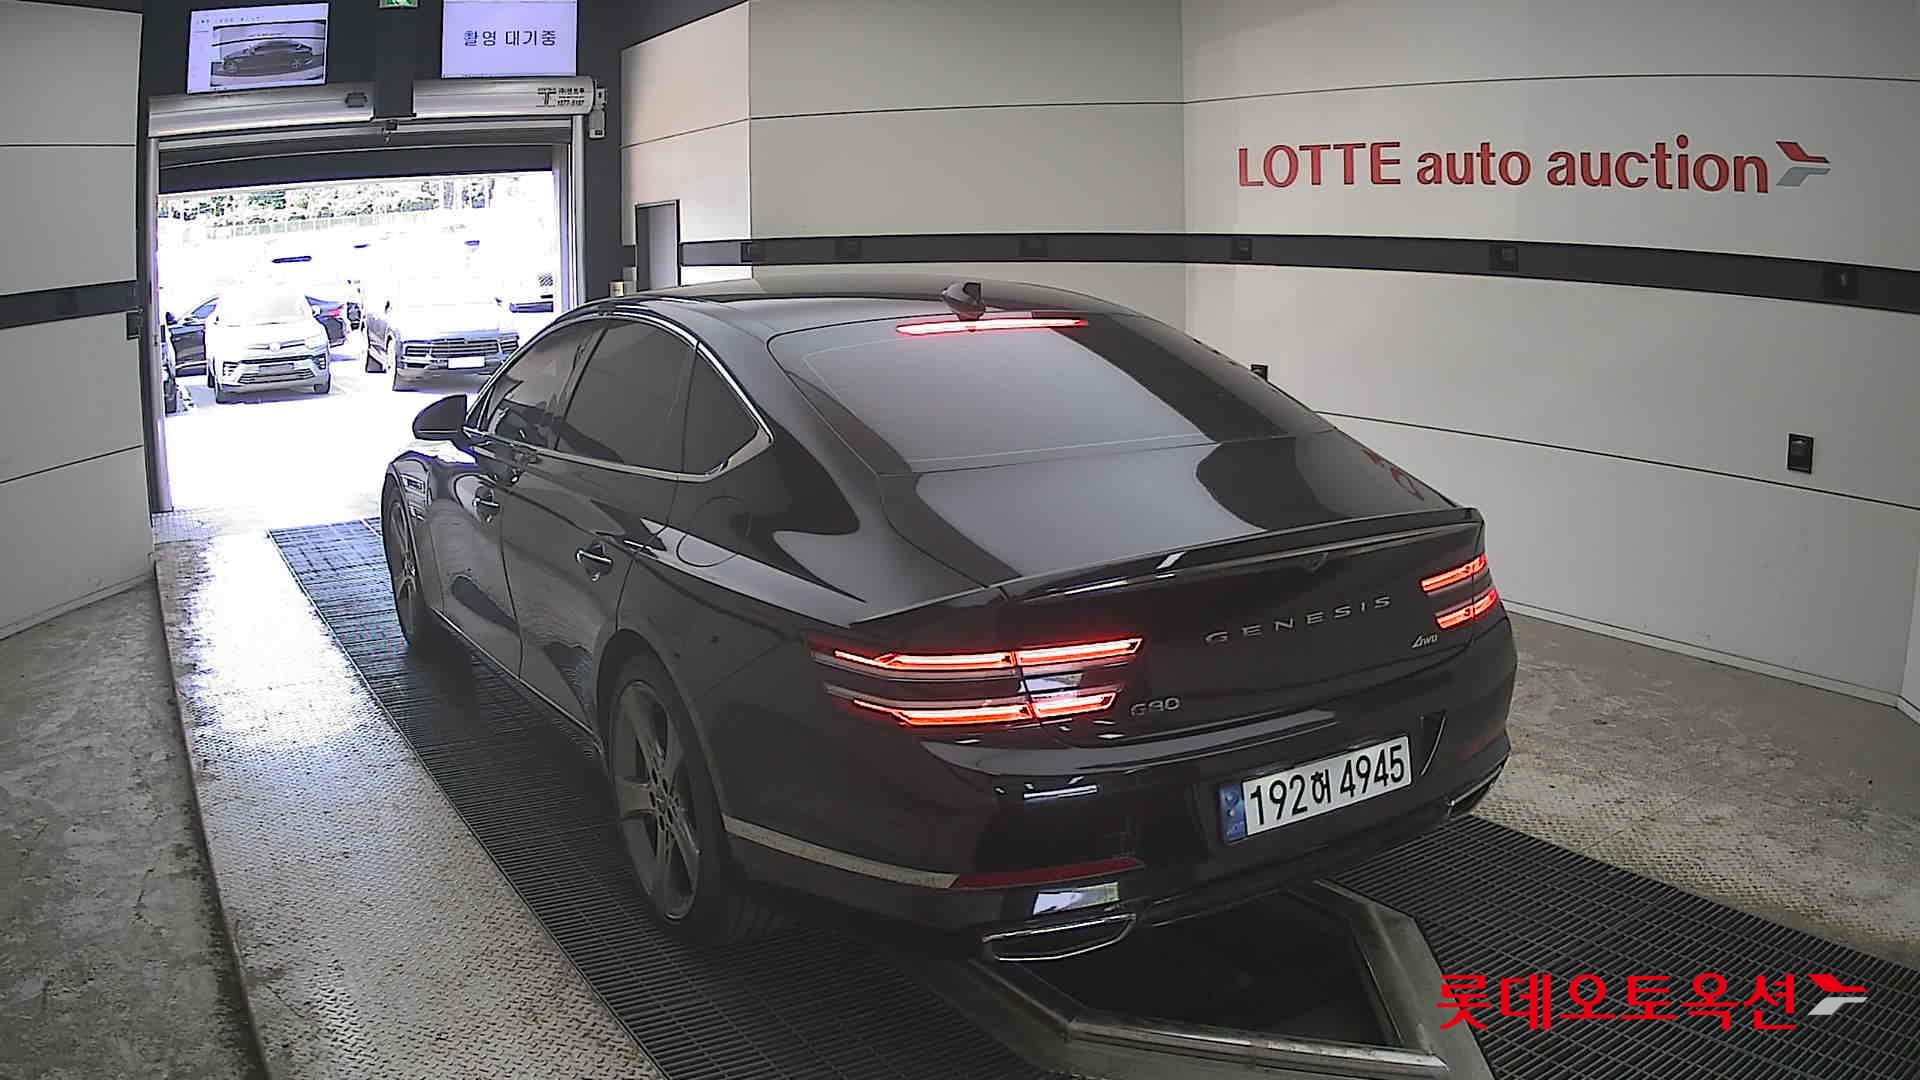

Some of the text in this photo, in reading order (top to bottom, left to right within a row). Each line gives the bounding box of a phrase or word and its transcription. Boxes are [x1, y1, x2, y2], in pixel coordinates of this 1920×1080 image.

[505, 30, 557, 47] 대기중
[1238, 134, 1769, 194] LOTTE auto auction
[1204, 595, 1392, 643] GENESIS
[1339, 744, 1405, 798] 4945
